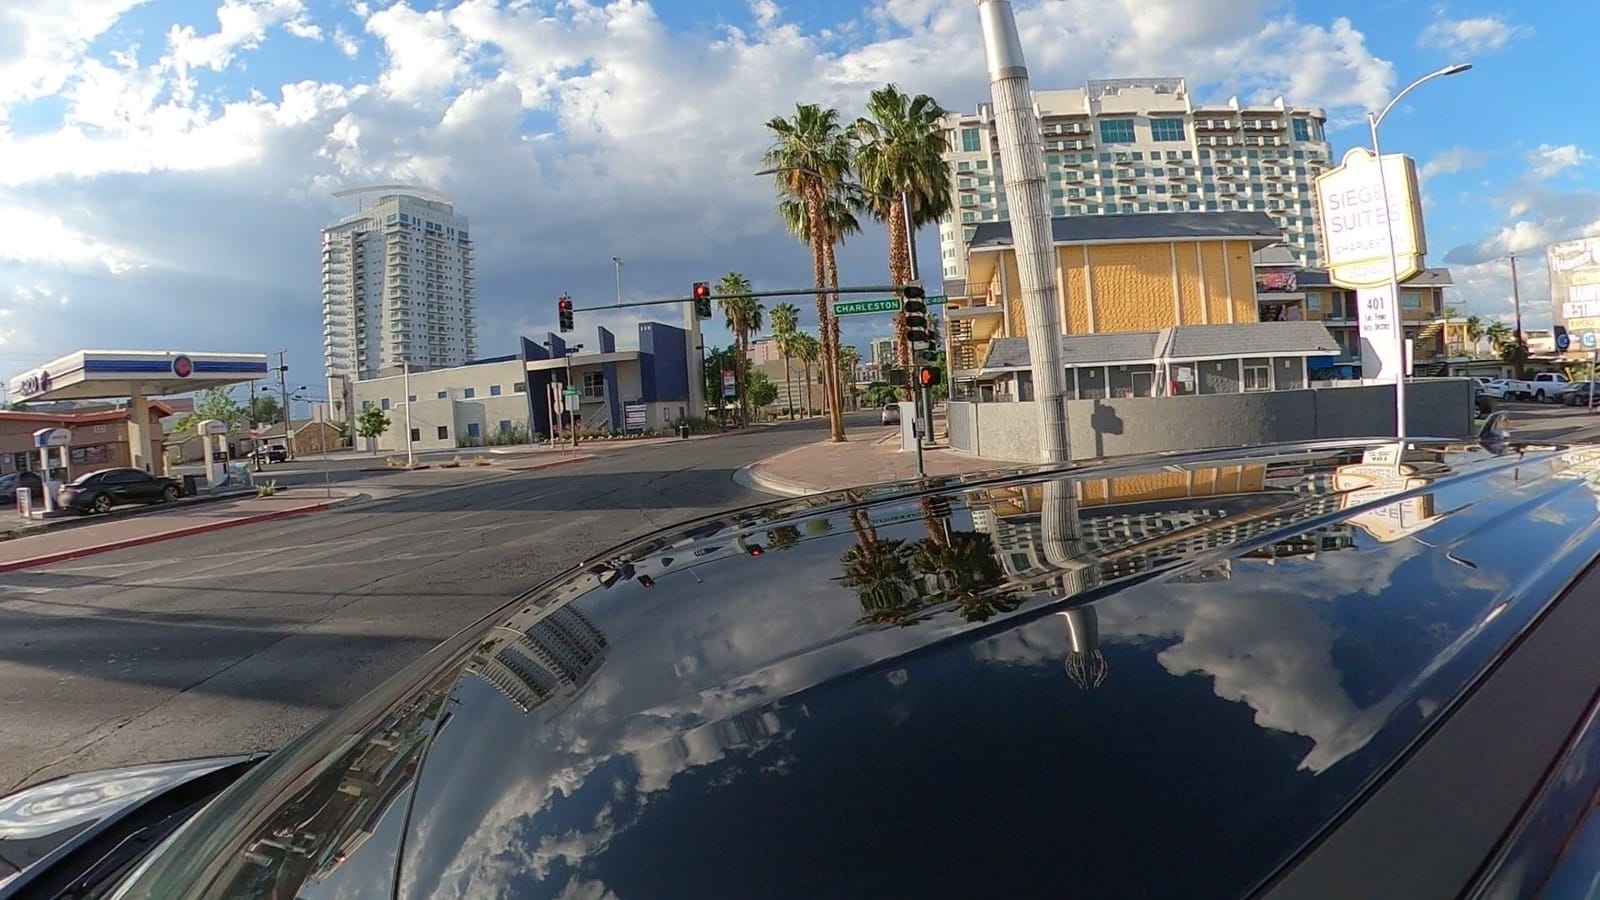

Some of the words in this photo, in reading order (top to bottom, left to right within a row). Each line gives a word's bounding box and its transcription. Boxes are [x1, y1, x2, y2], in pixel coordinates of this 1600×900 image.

[1331, 203, 1400, 233] SUITES
[835, 301, 899, 313] CHARLESTON
[1367, 296, 1384, 310] 401
